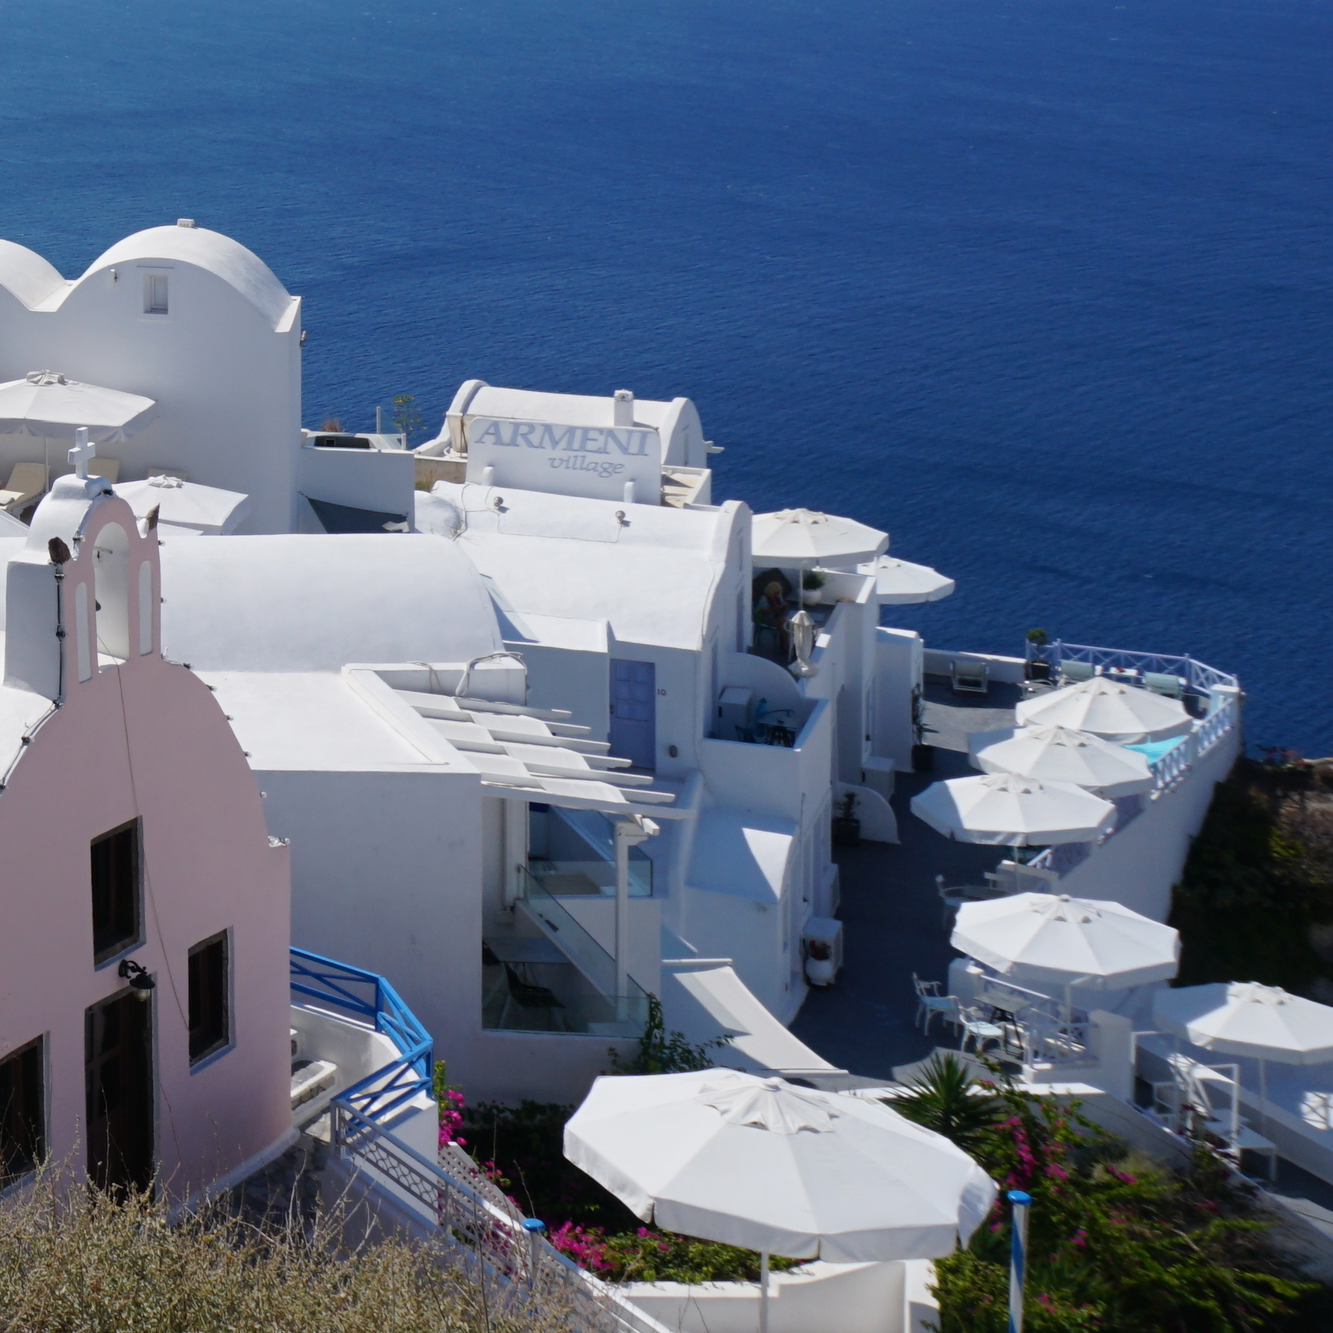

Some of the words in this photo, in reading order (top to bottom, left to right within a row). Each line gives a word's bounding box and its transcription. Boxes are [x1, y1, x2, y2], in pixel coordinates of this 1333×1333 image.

[474, 421, 654, 457] ARMENI
[548, 454, 626, 479] village
[656, 688, 667, 696] 10
